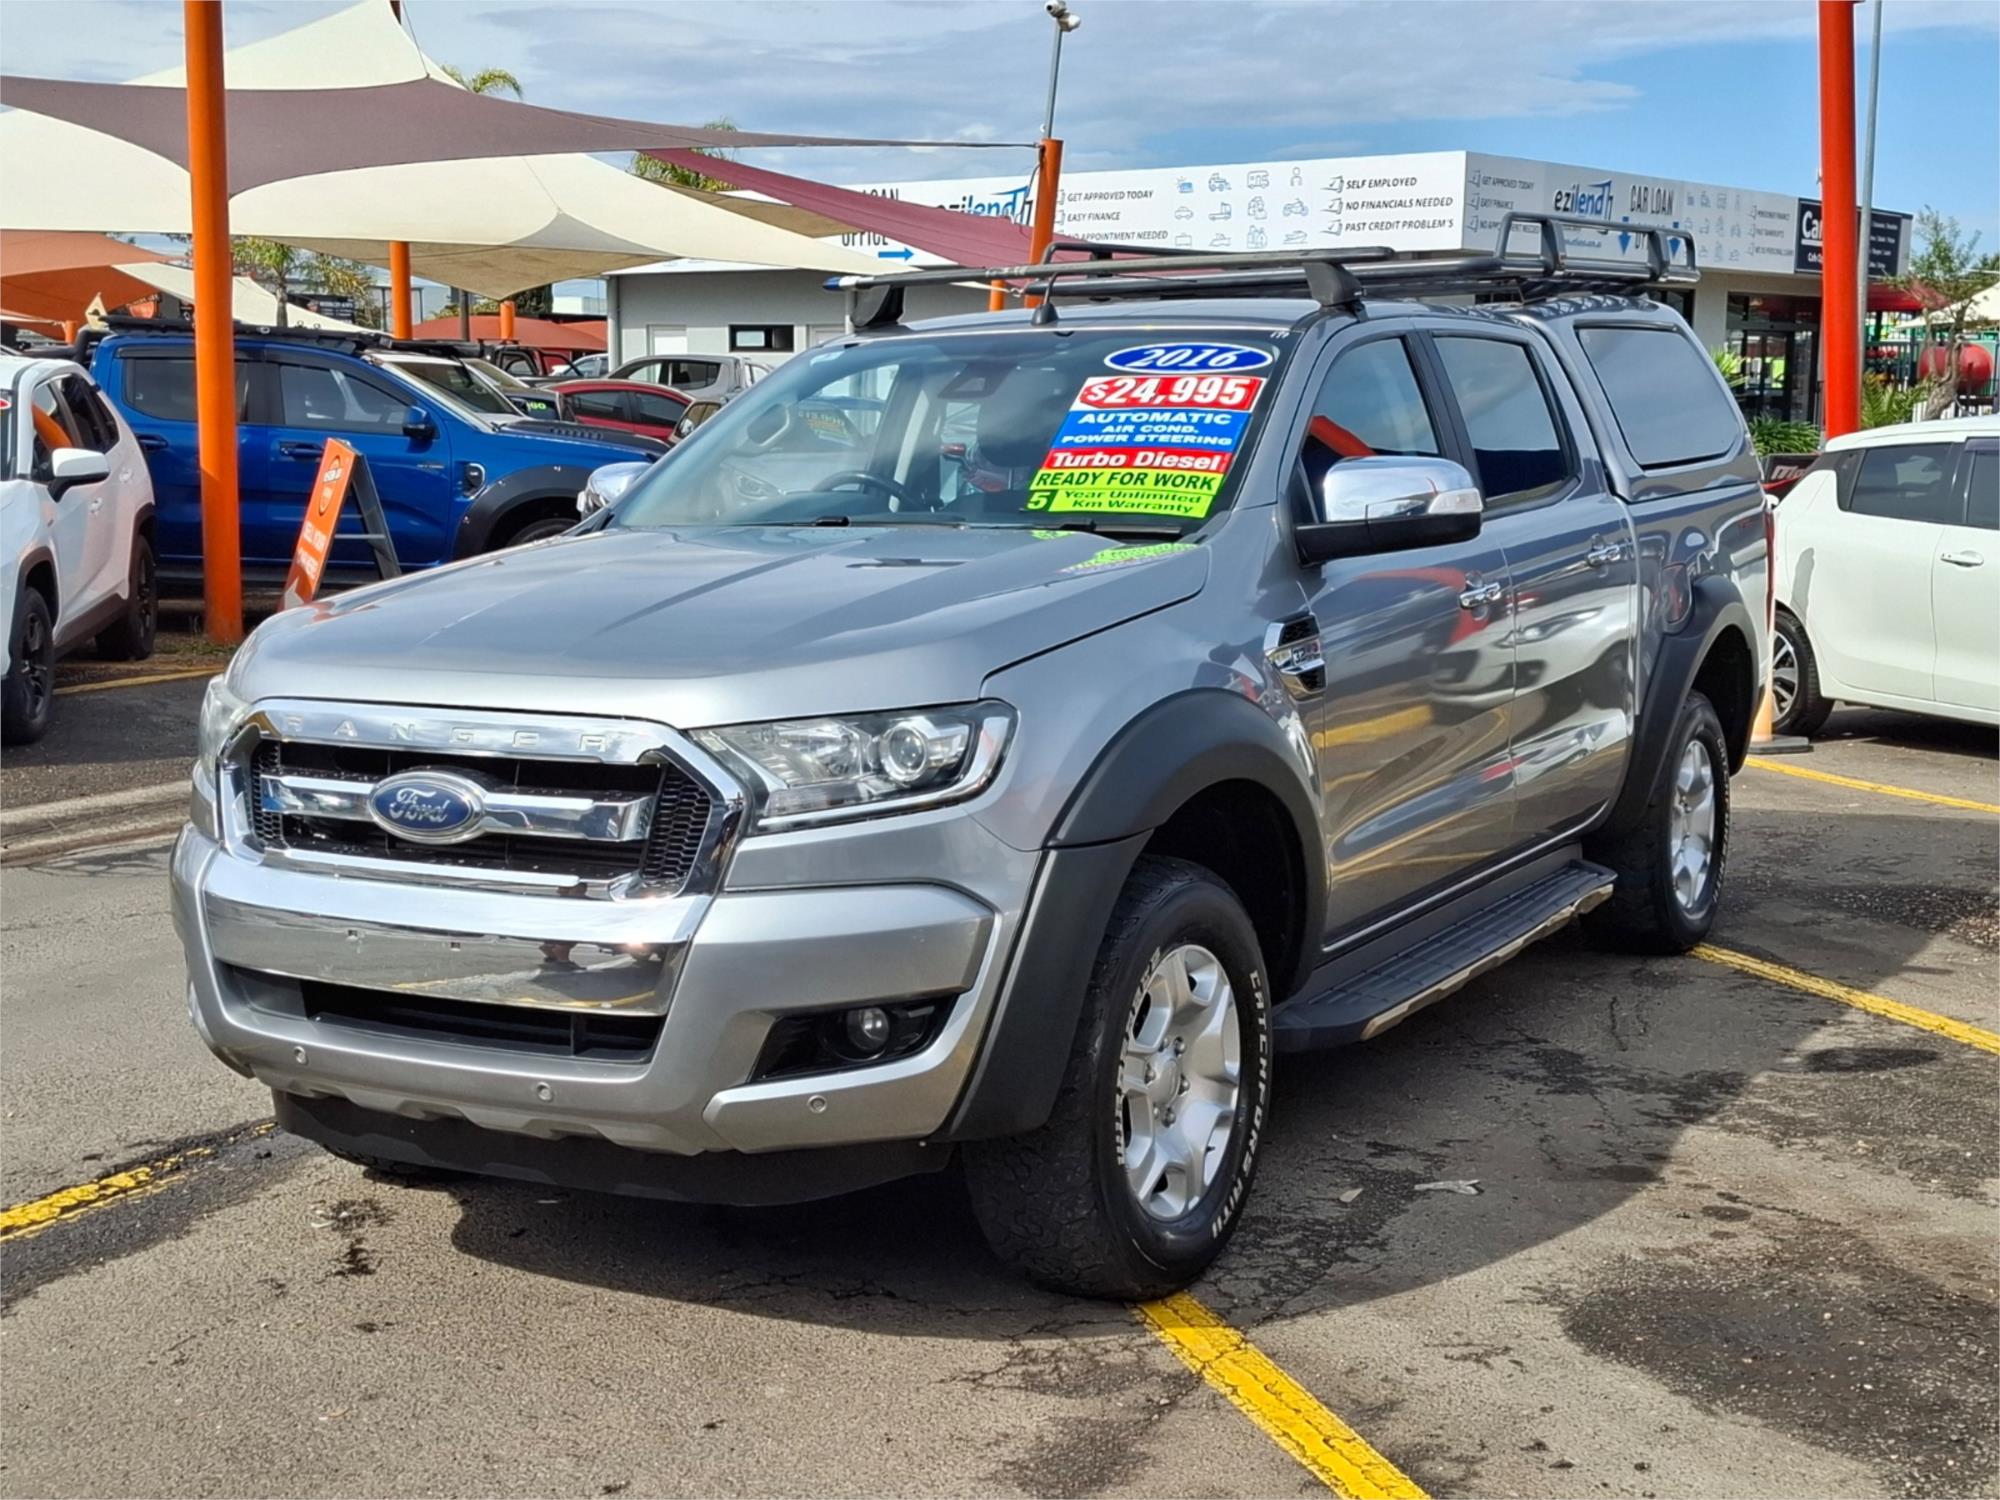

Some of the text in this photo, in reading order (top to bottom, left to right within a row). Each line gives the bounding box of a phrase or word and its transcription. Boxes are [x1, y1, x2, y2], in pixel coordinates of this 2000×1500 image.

[1346, 177, 1418, 190] SELF EMPLOYED
[1067, 190, 1154, 202] GET APPROVED TODAY
[1629, 185, 1674, 215] CAR LOAN
[1346, 197, 1454, 210] NO FINANCIALS NEEDED
[1067, 212, 1121, 222] EASY FINANCE
[1345, 219, 1454, 232] PAST CREDIT PROBLEM'S
[1082, 231, 1135, 241] APPOINTMENT
[1137, 230, 1168, 240] NEEDED
[1126, 349, 1239, 367] 2016
[1087, 377, 1250, 405] $24,995
[1078, 412, 1233, 425] AUTOMATIC
[1102, 425, 1200, 434] AIR COND.
[1061, 435, 1234, 446] POWER STEERING
[1052, 452, 1222, 471] Turbo Diesel
[1036, 472, 1217, 490] READY FOR WORK
[1027, 490, 1203, 510] 5 Year Unlimited
[1071, 500, 1194, 514] Km Warranty
[389, 787, 451, 823] Ford
